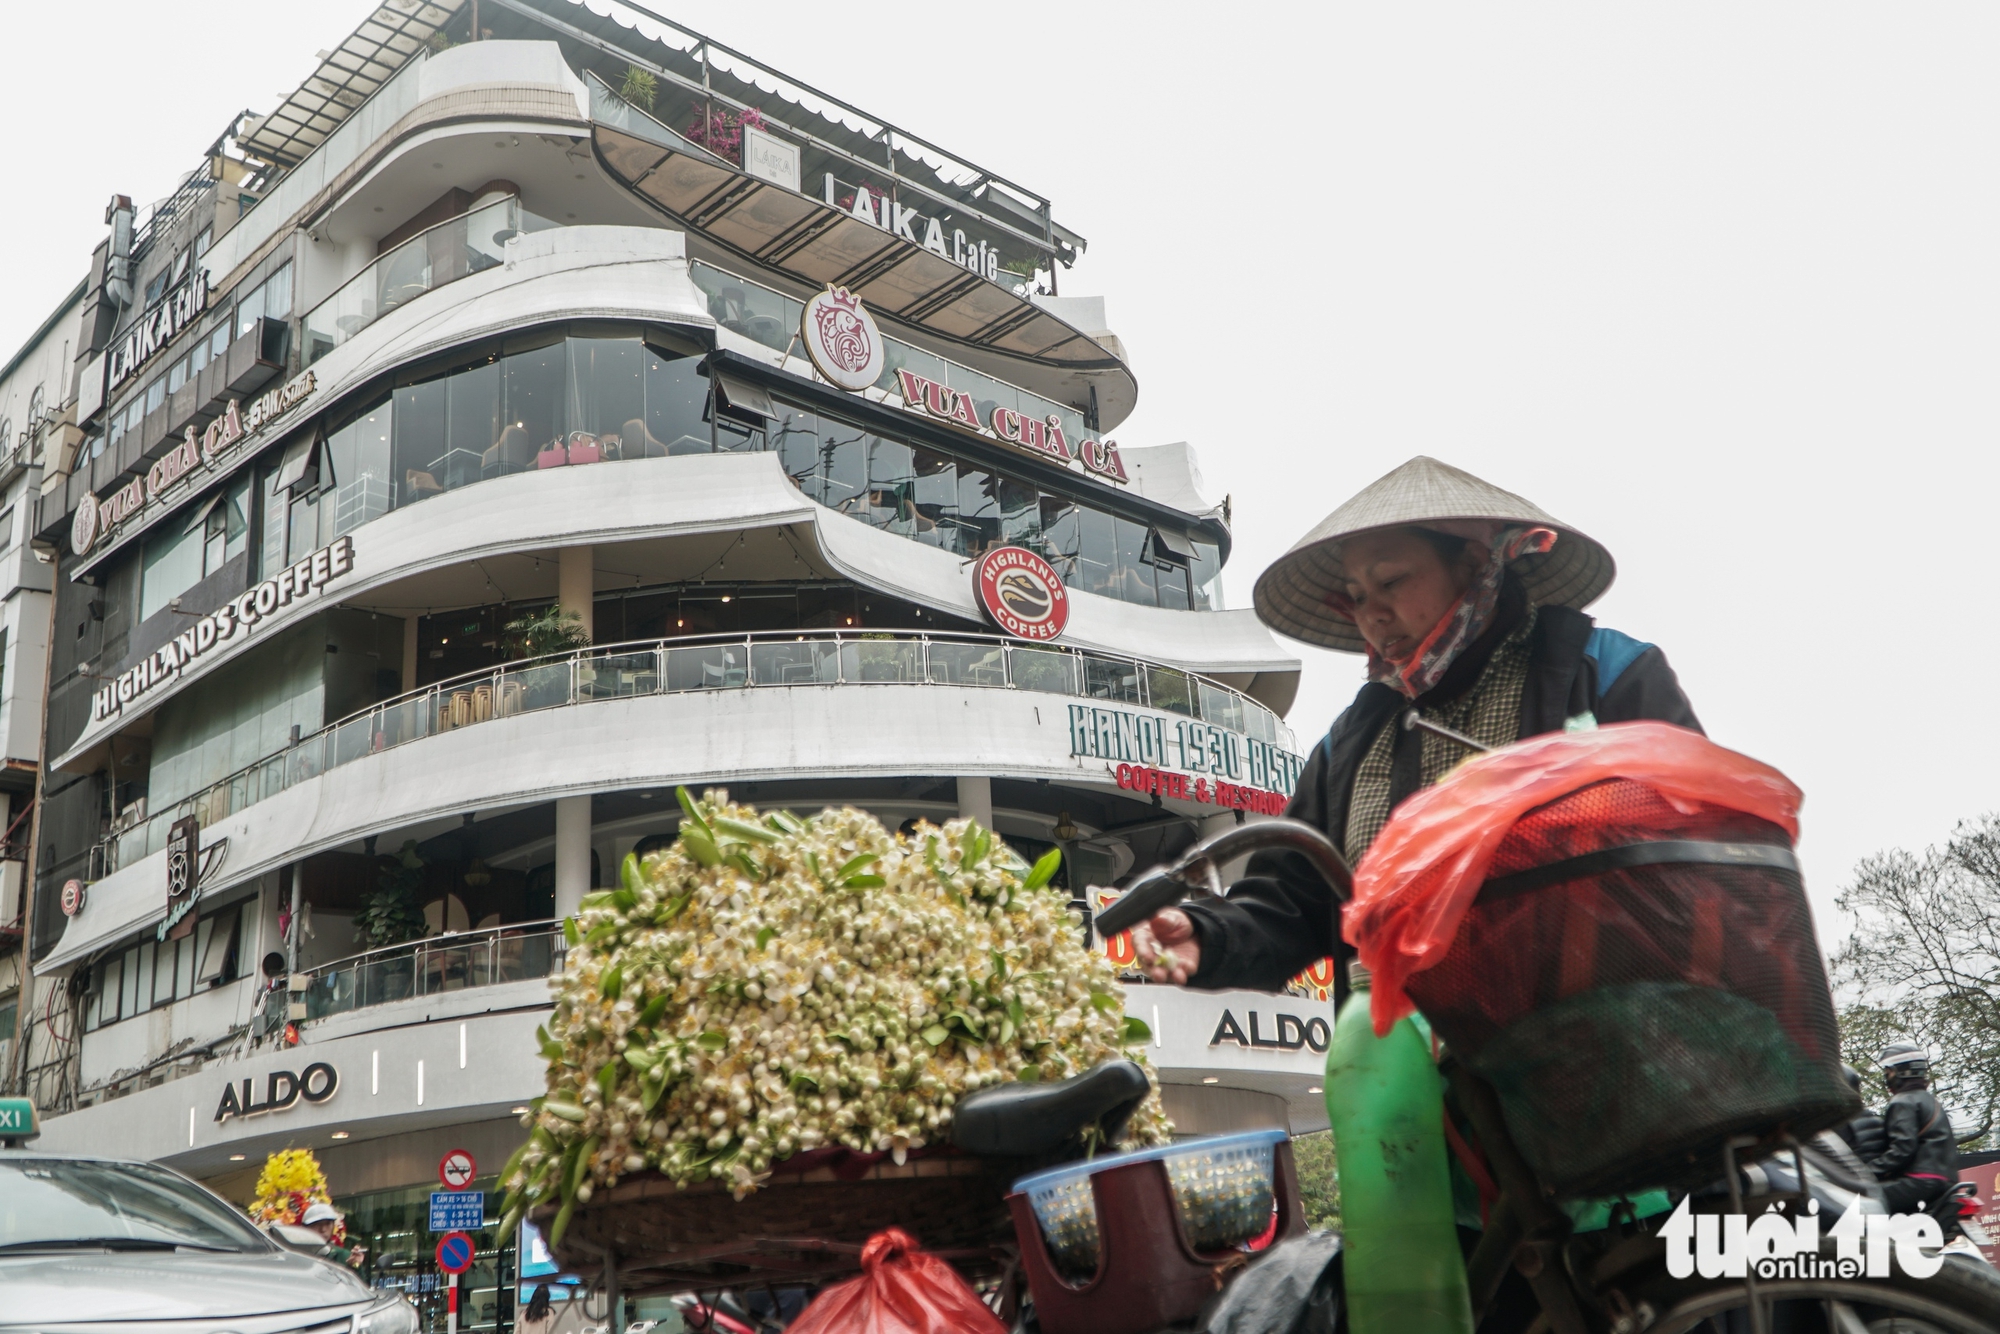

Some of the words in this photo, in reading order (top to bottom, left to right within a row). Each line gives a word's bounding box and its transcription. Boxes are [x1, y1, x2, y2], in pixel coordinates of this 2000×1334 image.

[824, 172, 948, 258] LAIKA
[953, 228, 1000, 282] Café
[109, 300, 174, 392] LAIKA
[176, 267, 209, 331] Café
[894, 368, 982, 430] VUA
[990, 414, 1073, 463] CHẢ
[1079, 439, 1130, 485] CÁ
[98, 475, 147, 533] VUA
[147, 425, 202, 496] CHẢ
[984, 552, 1064, 601] HIGHLANDS
[92, 604, 236, 722] HIGHLANDS
[237, 535, 353, 625] COFFEE
[996, 607, 1057, 638] COFFEE
[1067, 704, 1171, 768] HANOI
[1176, 720, 1243, 781] 1930
[1247, 738, 1305, 798] BISTR
[1116, 763, 1191, 801] COFFEE
[1195, 777, 1211, 804] &
[1215, 779, 1292, 817] RESTAUR
[1208, 1008, 1332, 1054] ALDO
[0, 1110, 21, 1128] XI
[213, 1062, 338, 1123] ALDO
